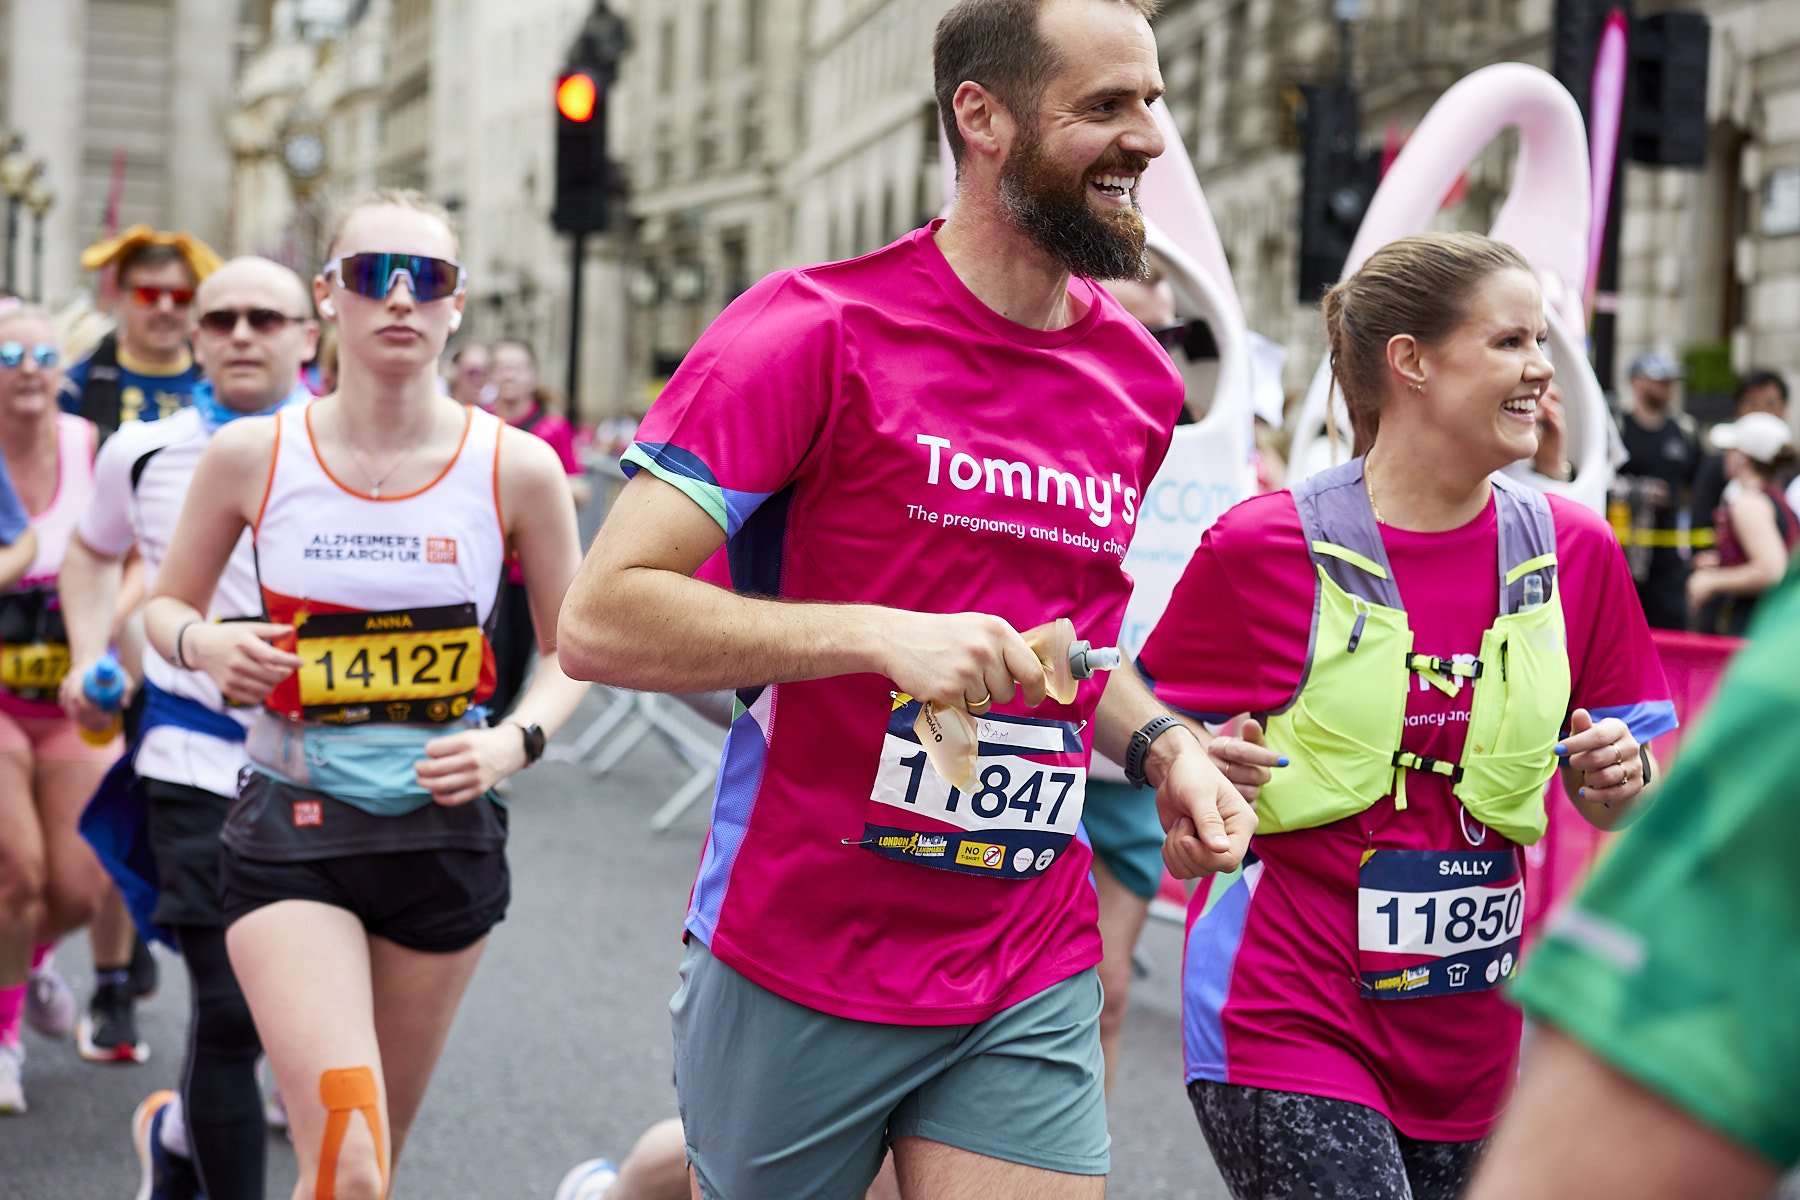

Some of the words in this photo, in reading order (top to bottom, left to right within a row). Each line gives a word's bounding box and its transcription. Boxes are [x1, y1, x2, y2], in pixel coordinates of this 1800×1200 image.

[917, 433, 1138, 528] Tommy's
[907, 504, 938, 523] The
[943, 512, 1026, 539] pregnancy
[1030, 526, 1059, 542] and
[1063, 527, 1100, 553] baby
[311, 534, 421, 548] ALZHEIMER'S
[303, 549, 394, 562] RESEARCH
[398, 550, 421, 563] UK
[364, 614, 414, 631] ANNA
[315, 641, 469, 692] 14127
[878, 836, 910, 848] LONDON
[965, 846, 980, 856] NO
[1439, 860, 1493, 876] SALLY
[1376, 887, 1522, 945] 11850
